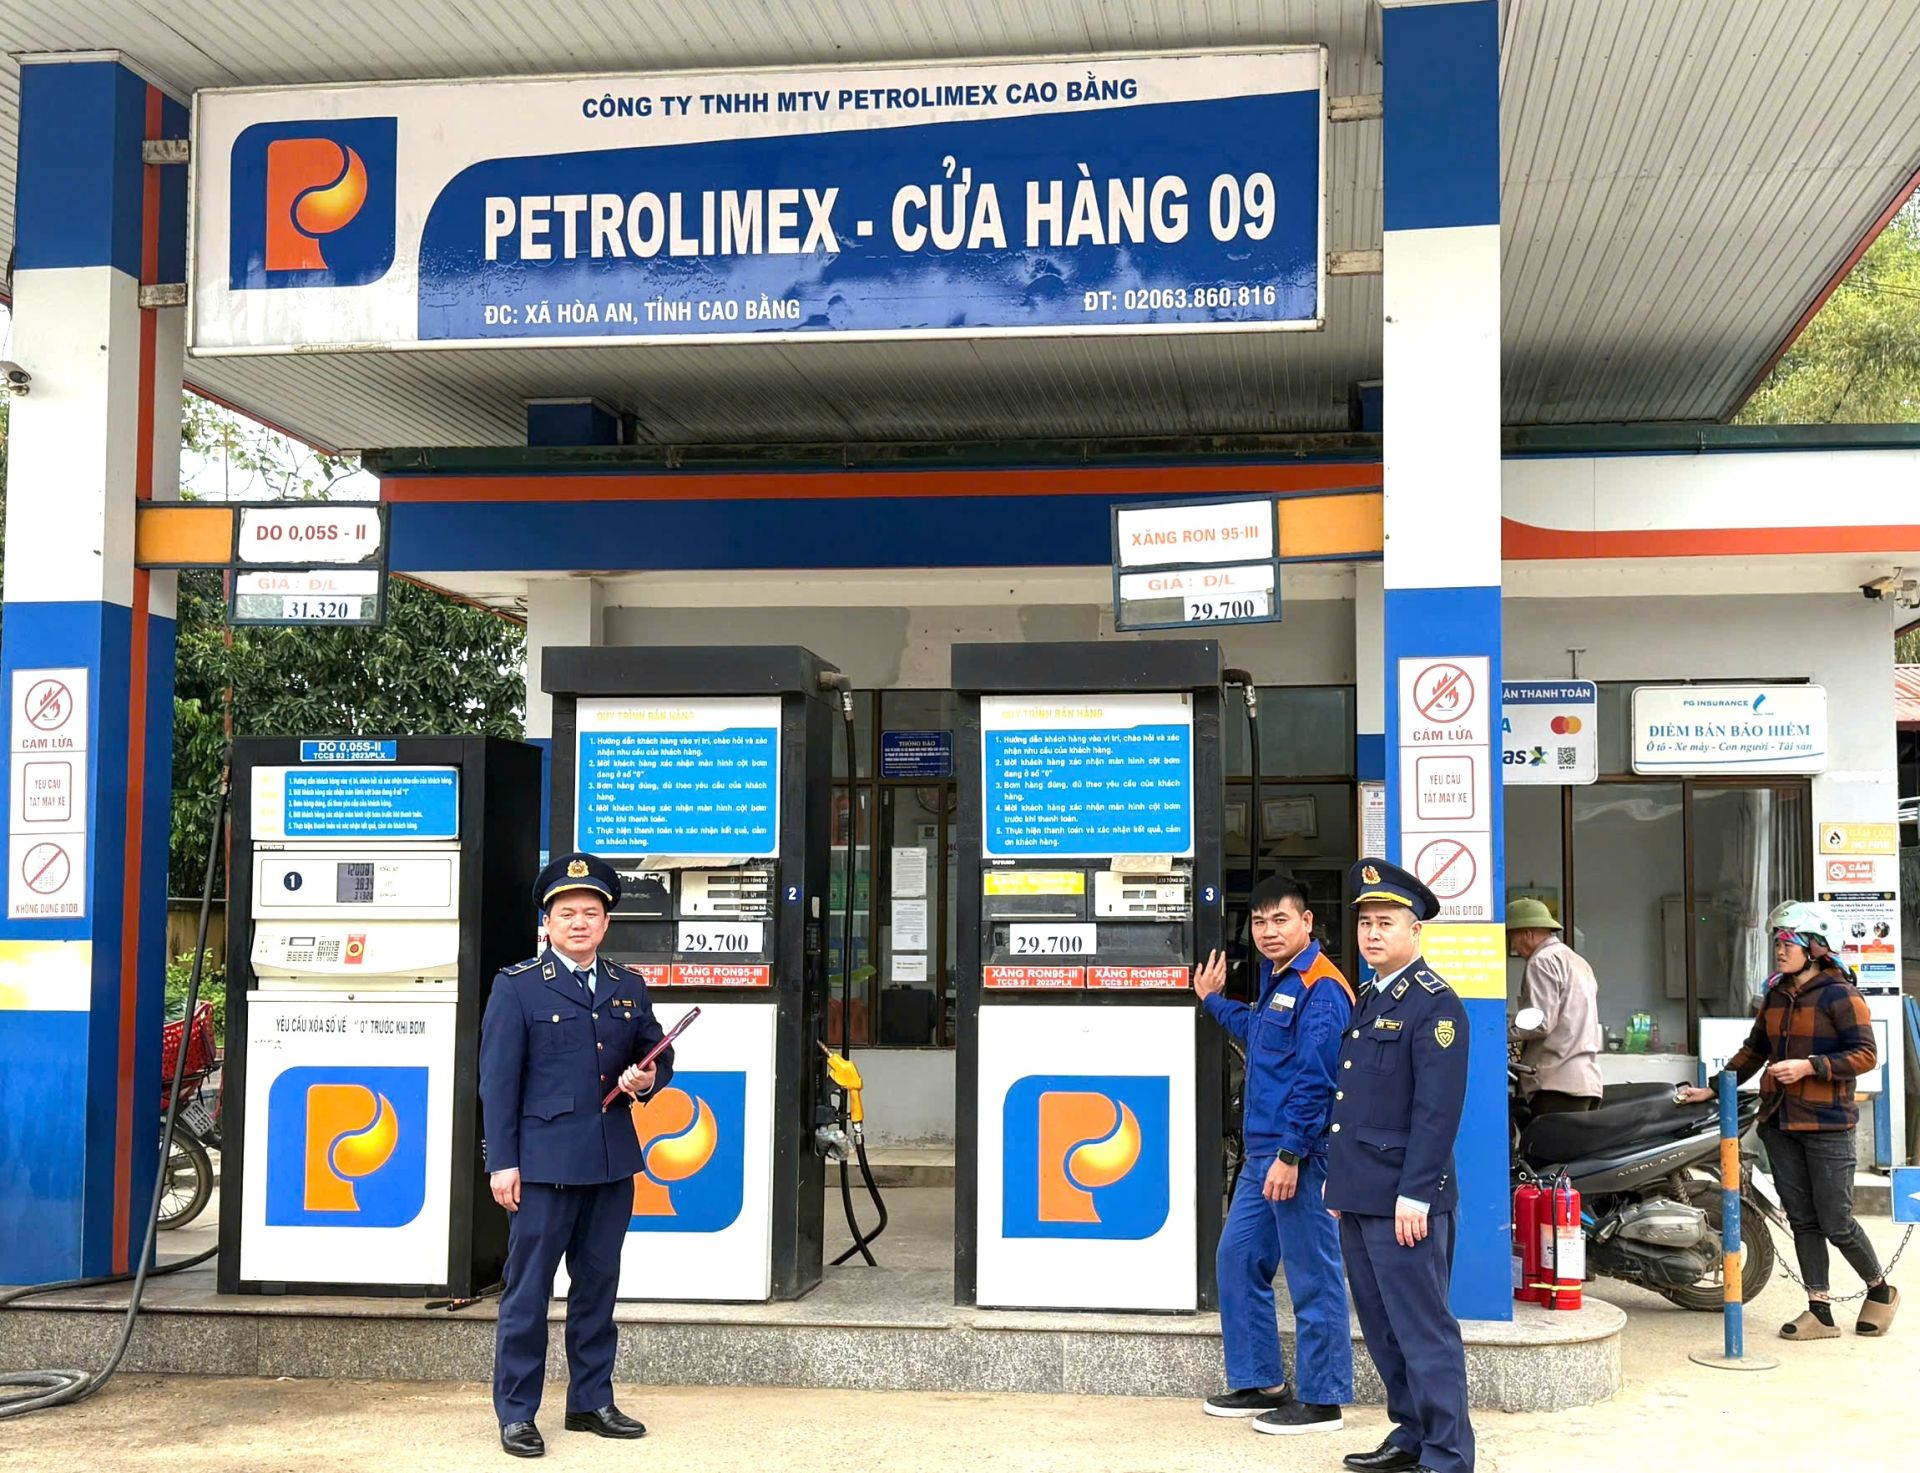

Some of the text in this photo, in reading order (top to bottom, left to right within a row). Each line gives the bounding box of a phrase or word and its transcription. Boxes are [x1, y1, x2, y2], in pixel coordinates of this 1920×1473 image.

[583, 71, 1138, 119] CÔNG TY TNHH MTV PETROLIMEX CAO BẰNG
[484, 188, 840, 261] PETROLIMEX
[891, 155, 1008, 252] CỬA
[1025, 162, 1189, 248] HÀNG
[1208, 171, 1277, 242] 09
[1083, 285, 1276, 311] ĐT: 02063.860.816
[484, 291, 801, 326] ĐC: XÃ HÒA AN, TỈNH CAO BẰNG
[257, 525, 282, 541] DO
[289, 525, 338, 542] 0,05S
[1132, 526, 1259, 546] XĂNG RON 95-III
[288, 602, 348, 618] 31.320
[1191, 600, 1254, 620] 29.700
[1521, 689, 1558, 698] THANH
[1561, 687, 1590, 697] TOÁN
[319, 743, 336, 751] DO
[1674, 742, 1688, 751] Xe
[1718, 742, 1738, 751] Con
[289, 875, 295, 887] 1
[789, 888, 796, 900] 2
[1206, 888, 1214, 900] 3
[685, 934, 749, 951] 29.700
[1017, 936, 1083, 953] 29.700
[679, 966, 762, 976] XĂNG RON95-III
[992, 967, 1077, 977] XĂNG RON95-III
[1095, 967, 1181, 978] XĂNG RON95-III
